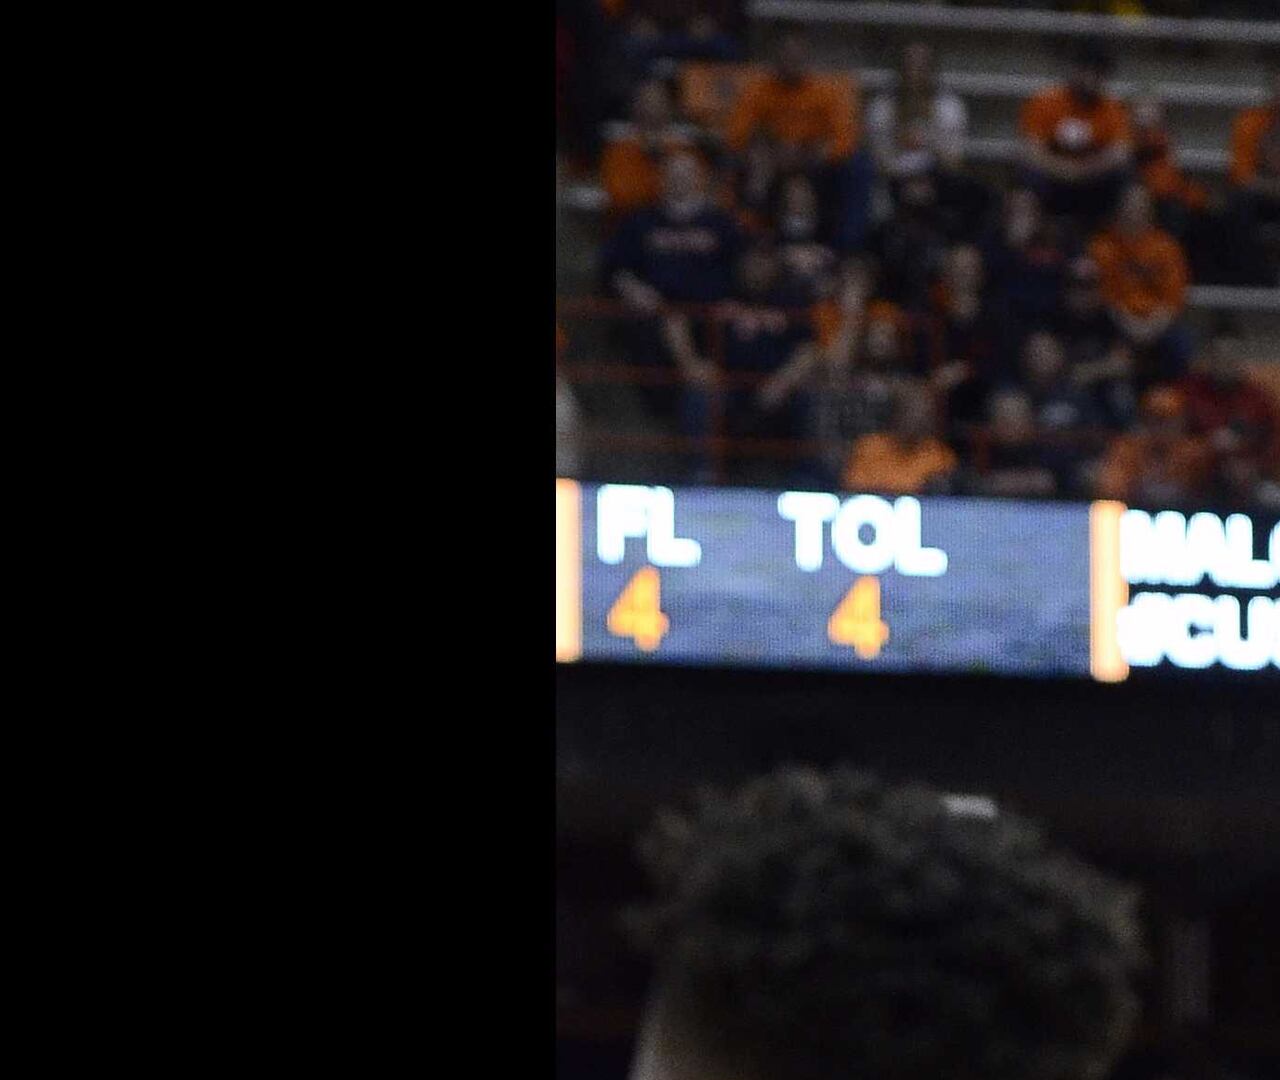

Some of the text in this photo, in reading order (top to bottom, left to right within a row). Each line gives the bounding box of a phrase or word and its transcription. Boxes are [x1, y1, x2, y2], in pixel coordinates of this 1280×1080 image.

[598, 484, 948, 577] FL TOL
[606, 566, 889, 659] 4 4
